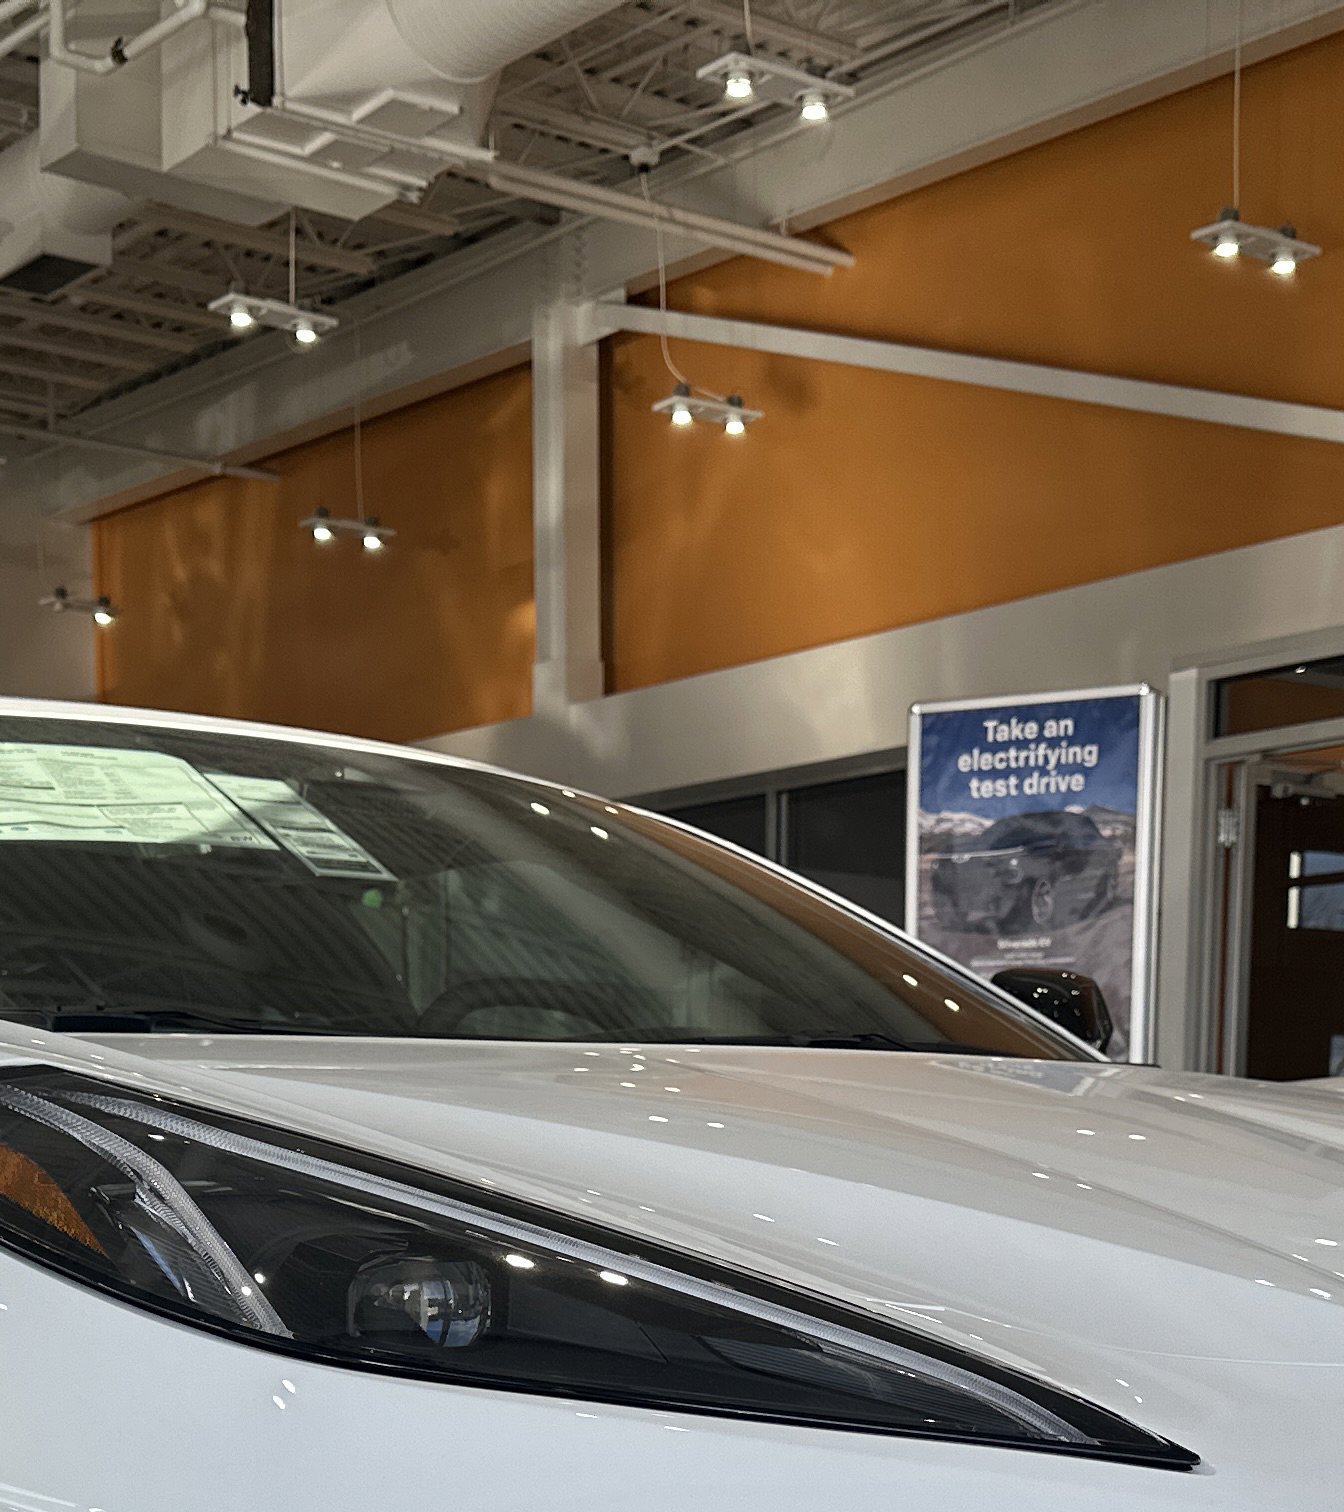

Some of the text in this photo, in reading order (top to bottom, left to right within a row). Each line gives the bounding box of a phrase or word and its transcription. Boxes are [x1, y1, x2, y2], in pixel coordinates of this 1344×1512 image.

[983, 716, 1074, 743] Take an
[957, 740, 1099, 772] electrifying
[968, 769, 1085, 799] test drive
